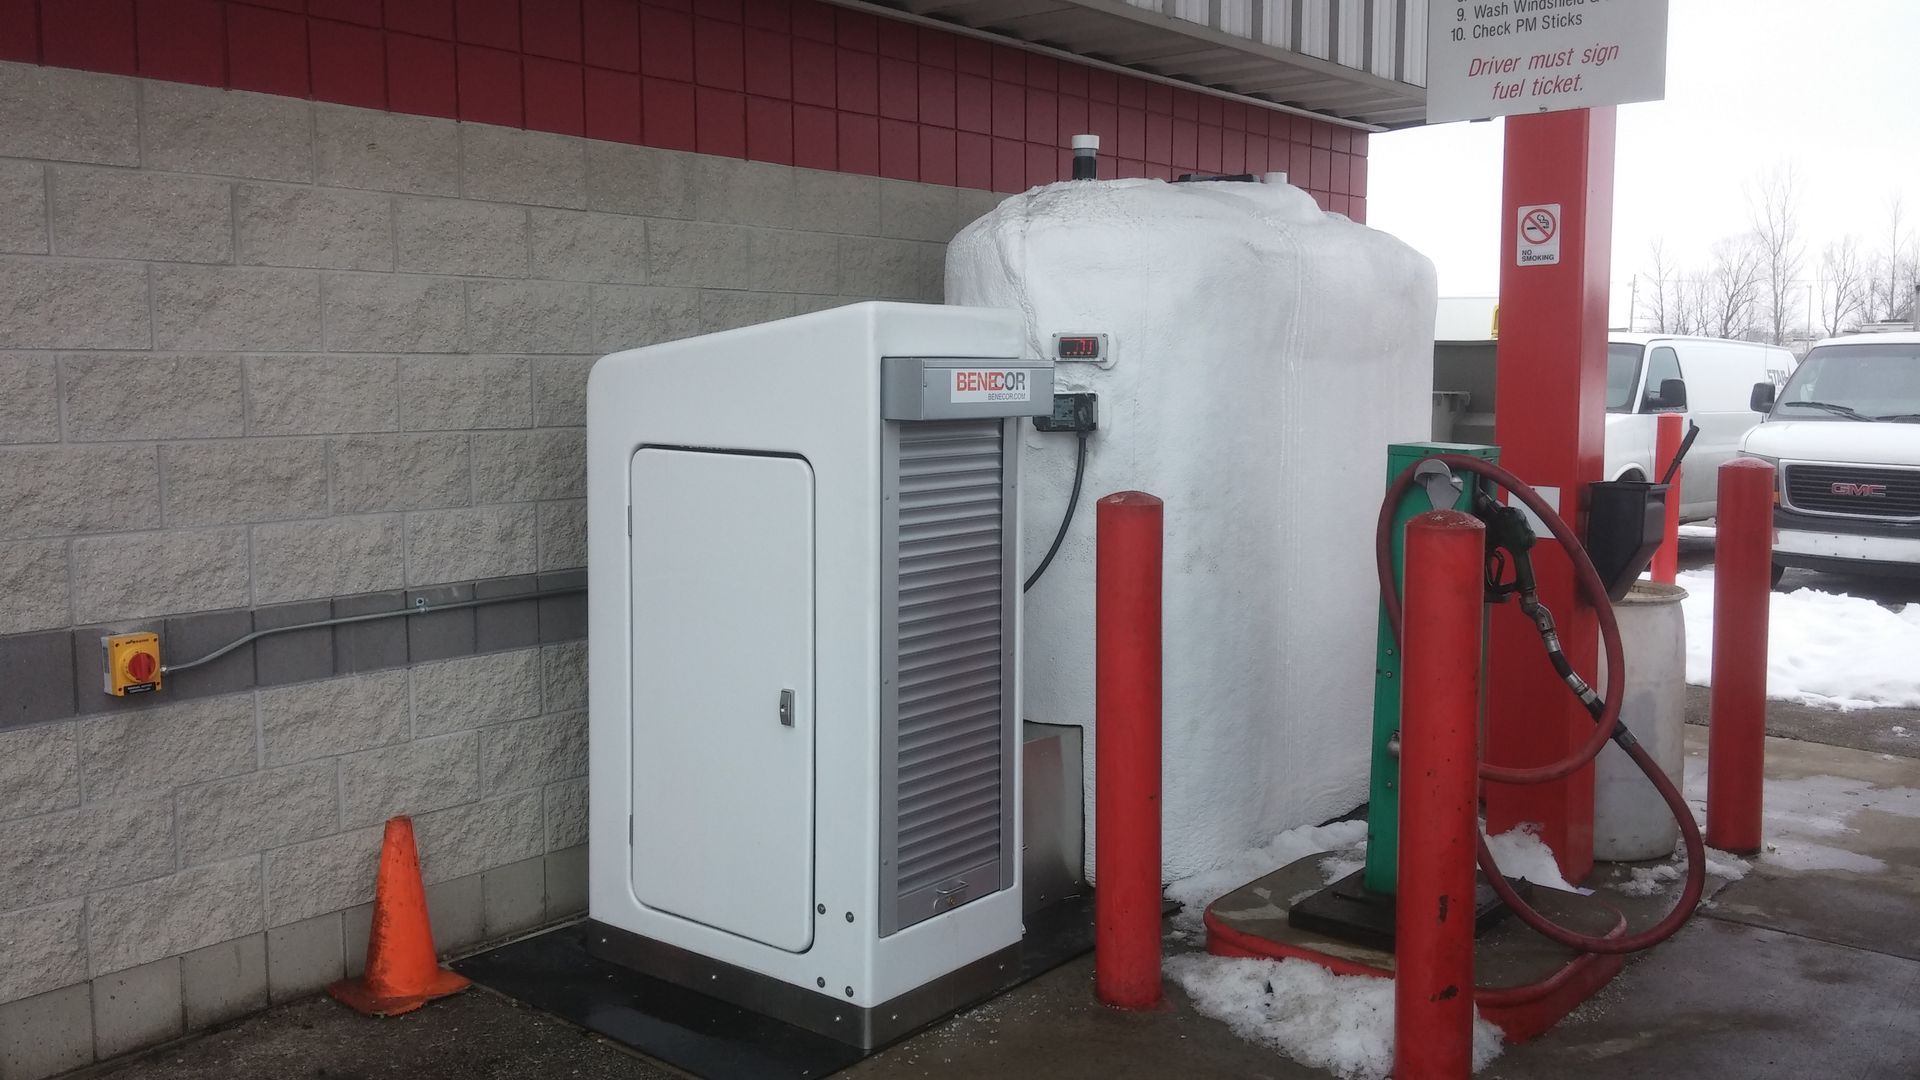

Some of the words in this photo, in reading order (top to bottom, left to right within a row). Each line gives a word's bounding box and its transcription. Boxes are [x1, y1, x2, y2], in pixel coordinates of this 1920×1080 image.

[1457, 8, 1466, 22] 9.
[1474, 2, 1508, 19] Wash
[1451, 27, 1466, 42] 10.
[1473, 21, 1511, 39] Check
[1516, 17, 1537, 33] PM
[1541, 12, 1583, 30] Sticks
[1468, 56, 1521, 77] Driver
[1528, 48, 1574, 70] must
[1581, 43, 1620, 66] sign
[1492, 79, 1525, 100] fuel
[1531, 72, 1584, 97] ticket.
[1521, 254, 1554, 262] SMOKING
[957, 371, 1026, 391] BENECOR
[988, 392, 1026, 400] BENECOR.COM
[1831, 482, 1887, 497] GMC
